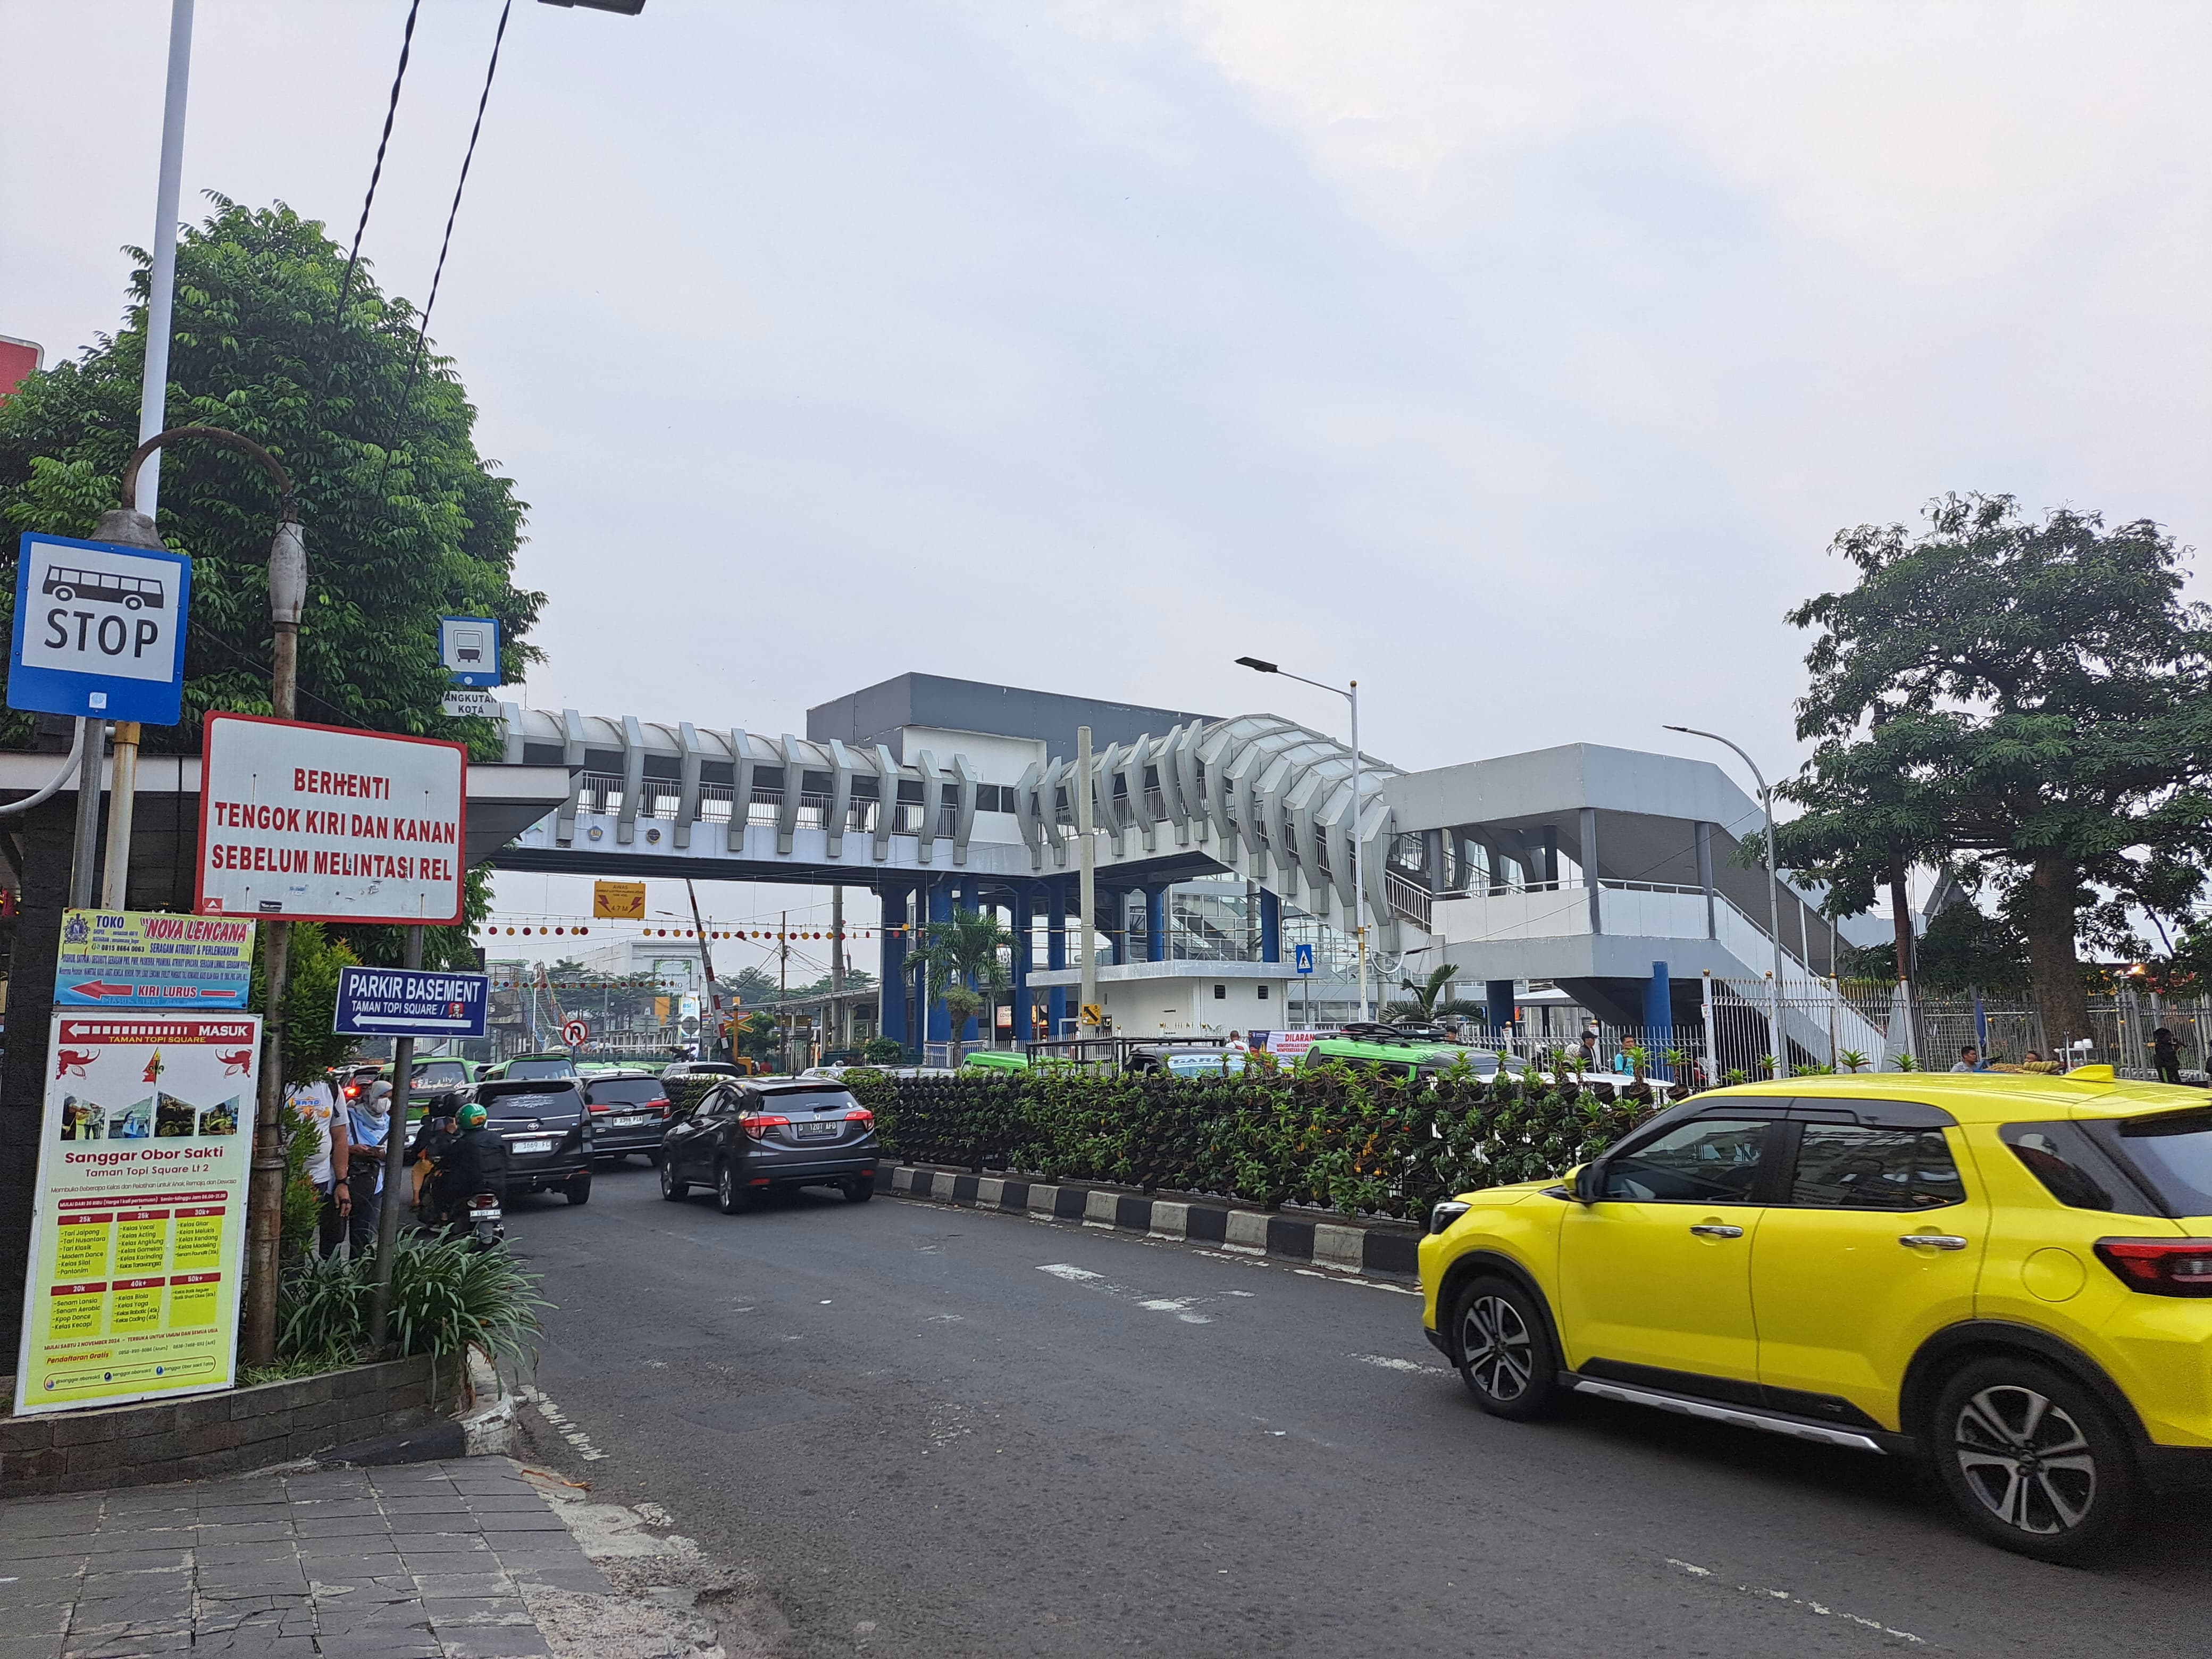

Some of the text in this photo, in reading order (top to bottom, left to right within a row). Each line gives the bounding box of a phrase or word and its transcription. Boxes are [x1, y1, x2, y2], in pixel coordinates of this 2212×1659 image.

[44, 608, 158, 658] STOP
[458, 705, 484, 714] KOTA
[294, 768, 390, 800] BERHENTI
[215, 801, 456, 844] TENGOK KIRI DAN KANAN
[212, 844, 453, 881] SEBELUM MELINTASI REL
[96, 916, 124, 928] TOKO
[150, 943, 239, 957] SERAGAM ATRIBUT & PERLENGKAPAN
[138, 985, 197, 998] KIRI LURUS
[348, 974, 481, 1003] PARKIR BASEMENT
[351, 1000, 446, 1016] TAMAN TOPI SQUARE /
[198, 1025, 248, 1036] MASUK
[1285, 1033, 1316, 1042] DILARAN
[65, 1145, 223, 1166] Sanggar Obor Sakti
[86, 1169, 123, 1178] Taman
[127, 1166, 148, 1177] Topi
[152, 1165, 189, 1175] Square
[47, 1355, 88, 1364] Pendaftaran
